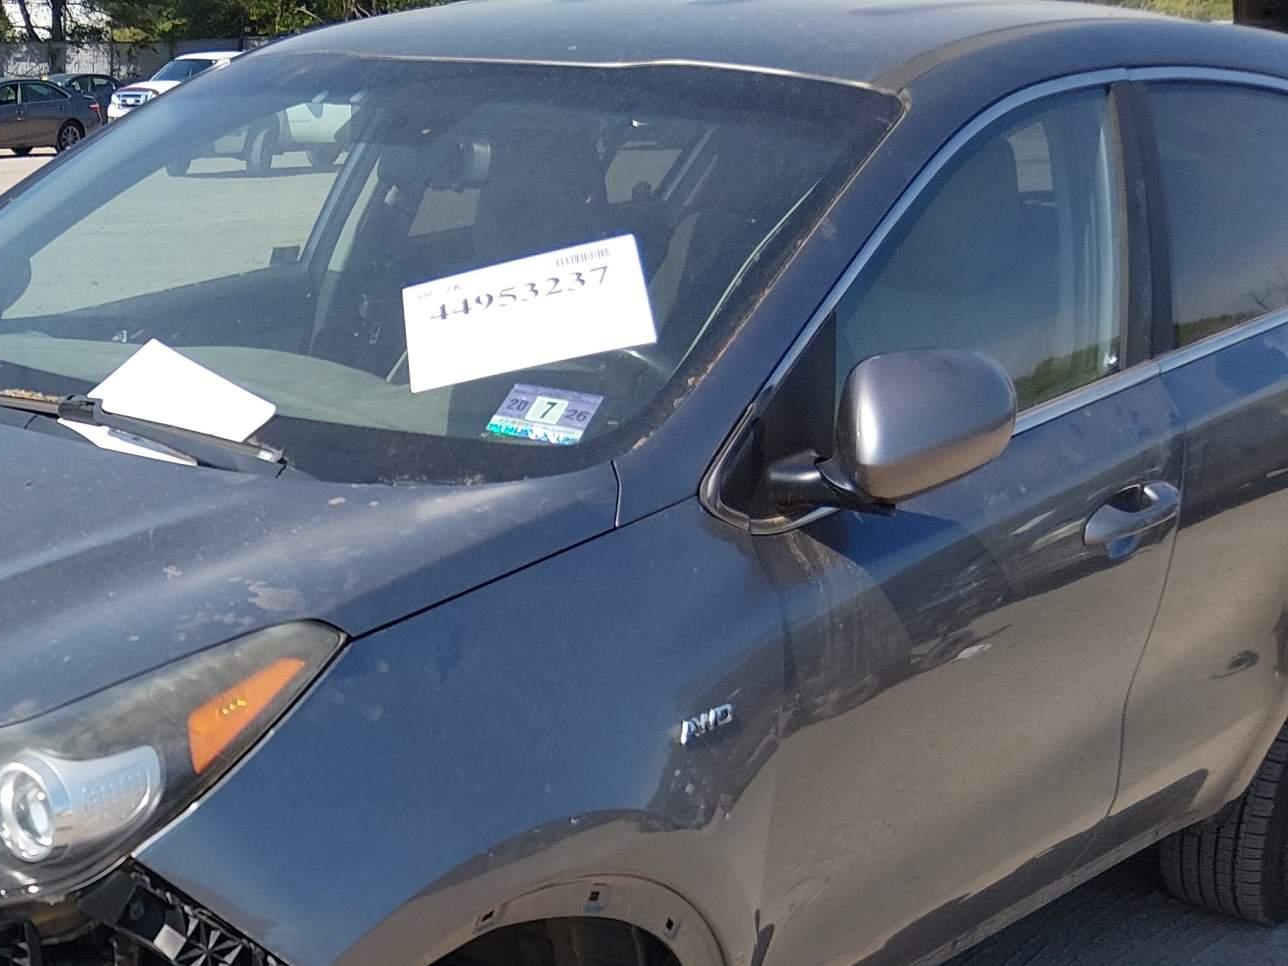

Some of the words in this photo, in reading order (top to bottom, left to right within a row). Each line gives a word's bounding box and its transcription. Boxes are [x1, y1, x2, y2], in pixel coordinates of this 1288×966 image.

[430, 265, 609, 320] 44953237
[507, 398, 529, 412] 20
[540, 401, 558, 419] 7
[564, 409, 590, 422] 26
